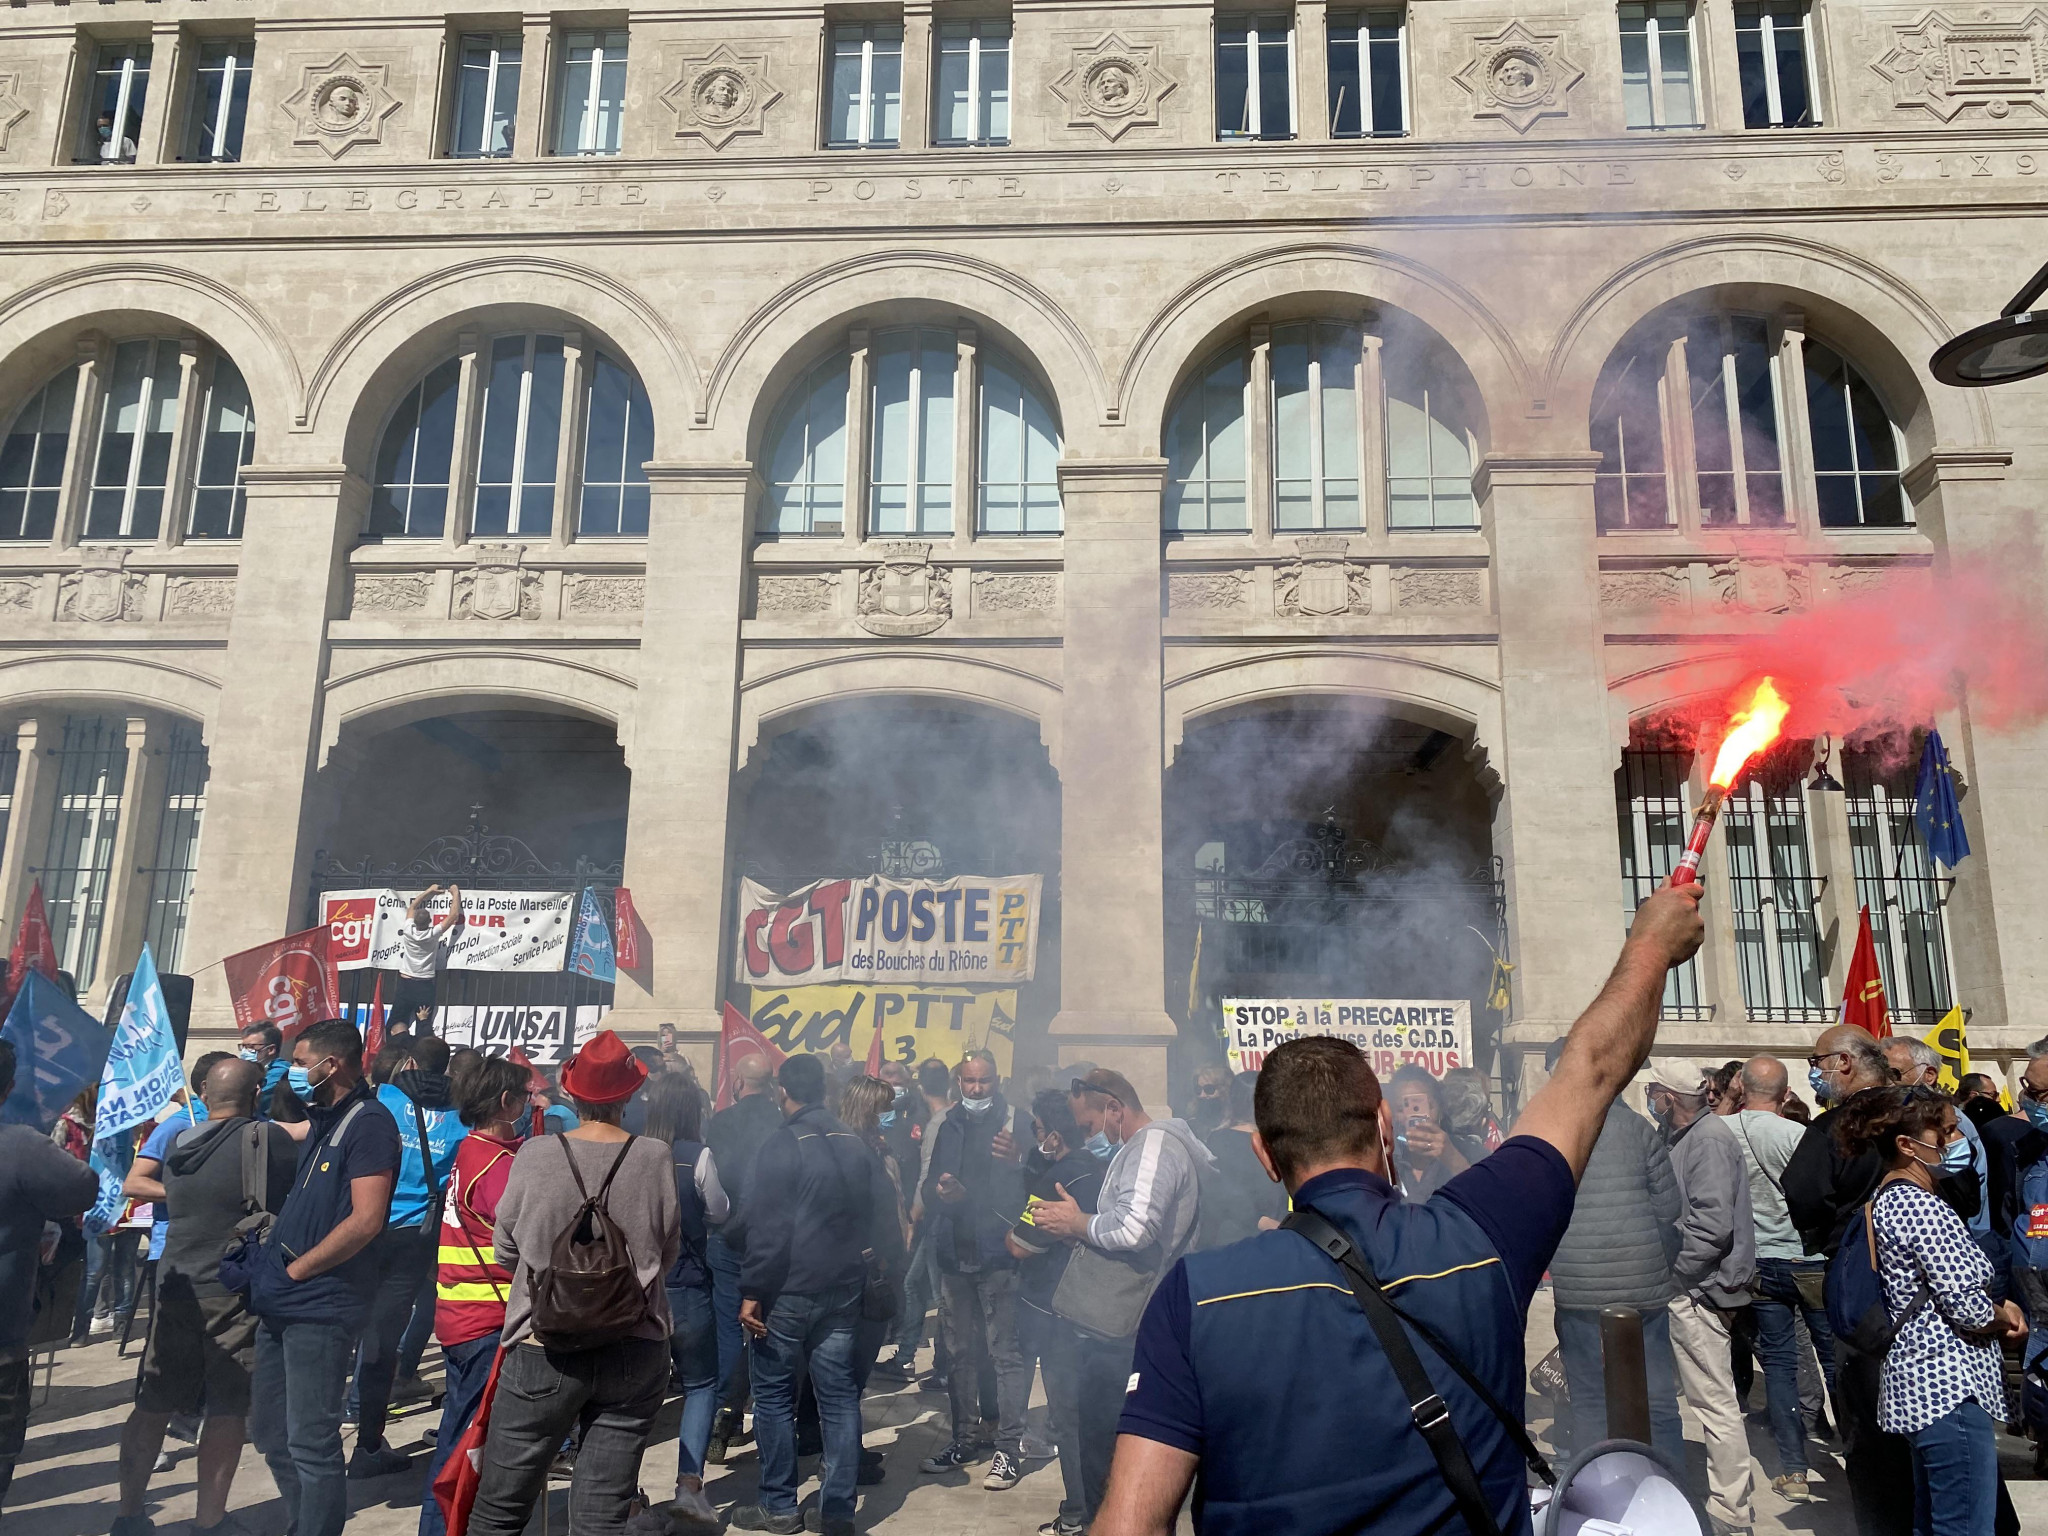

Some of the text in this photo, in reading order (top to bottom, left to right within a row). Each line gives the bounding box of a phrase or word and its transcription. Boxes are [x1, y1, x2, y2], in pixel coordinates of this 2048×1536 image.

[211, 163, 1637, 213] TELEGRAPHE POSTE TELEPHONE
[329, 902, 371, 922] la
[461, 898, 473, 910] de
[476, 898, 485, 910] la
[488, 898, 517, 911] Poste
[520, 899, 568, 911] Marseille
[331, 914, 373, 948] cgt
[744, 880, 990, 977] CGT POSTE
[999, 894, 1025, 964] PTT
[513, 934, 565, 966] Service Public
[852, 949, 988, 971] des Bouches du Rhône
[264, 975, 302, 1031] cgt
[1236, 1006, 1455, 1026] STOP à la PRECARITE
[480, 1011, 561, 1041] UNSA
[752, 991, 866, 1052] Sud
[872, 993, 976, 1031] PTT
[1238, 1028, 1258, 1047] La
[1372, 1029, 1404, 1048] des
[1408, 1028, 1459, 1048] C.D.D.
[1539, 1360, 1564, 1388] Berlin
